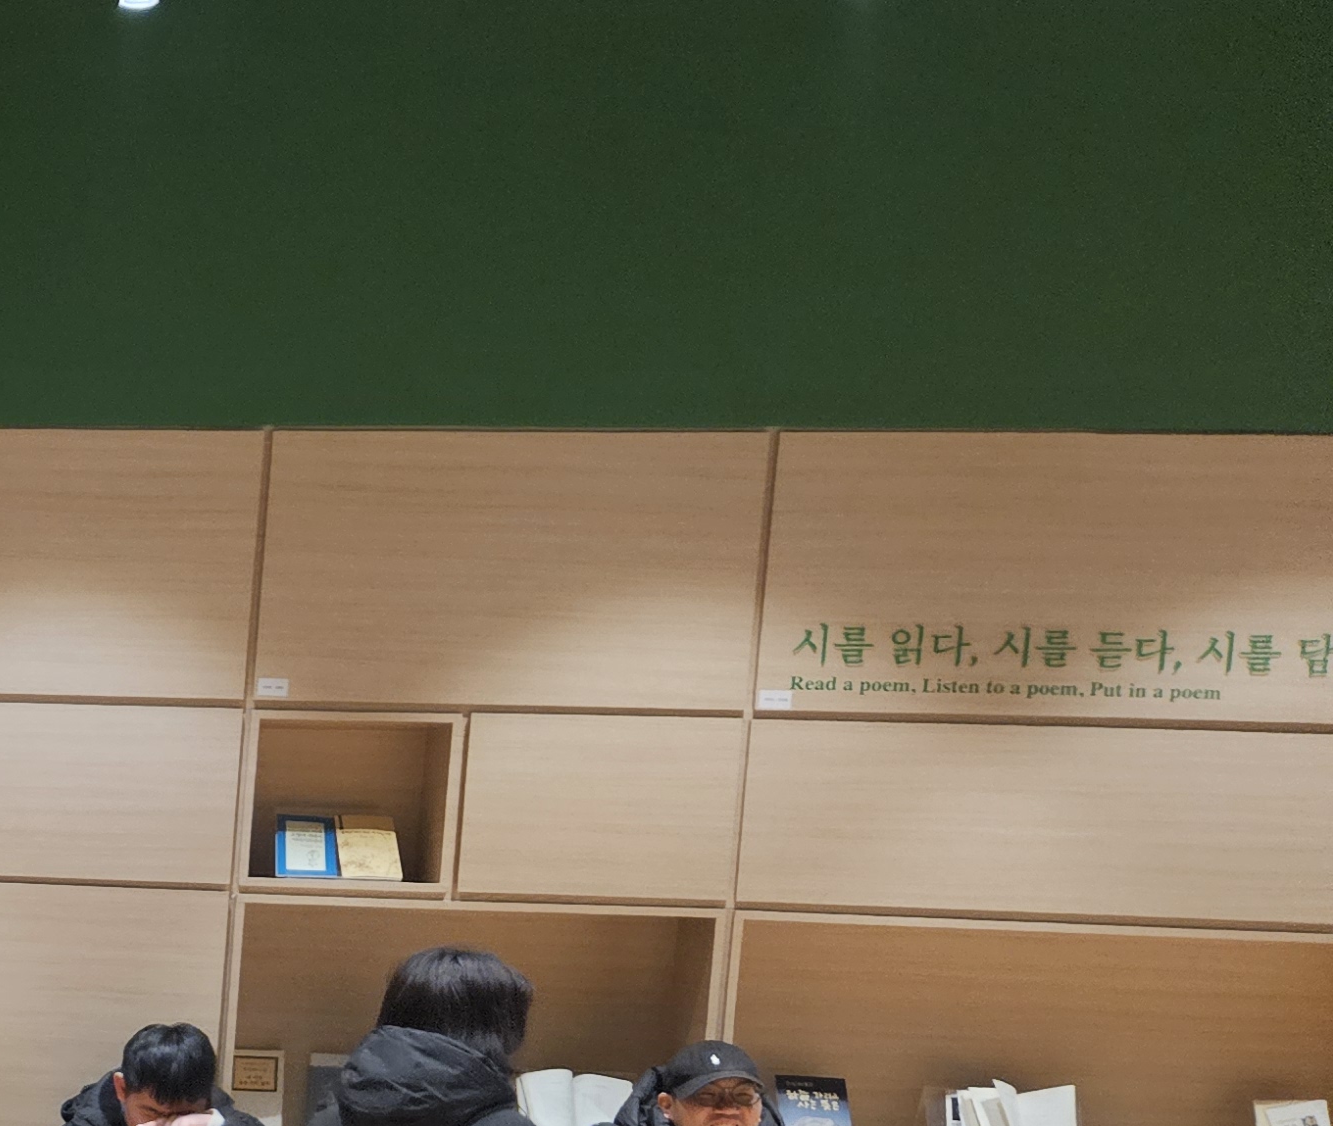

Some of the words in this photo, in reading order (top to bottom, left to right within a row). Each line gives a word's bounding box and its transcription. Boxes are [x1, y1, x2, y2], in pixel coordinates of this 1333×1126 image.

[793, 622, 874, 668] 시를
[891, 623, 979, 668] 읽다,
[993, 625, 1077, 669] 시를
[1089, 629, 1183, 676] 듣다,
[1196, 630, 1282, 676] 시를
[789, 675, 837, 692] Read
[843, 681, 853, 691] a
[859, 680, 917, 696] poem,
[922, 678, 980, 694] Listen
[986, 681, 1005, 695] to
[1010, 684, 1021, 695] a
[1026, 683, 1085, 699] poem,
[1090, 681, 1123, 698] Put
[1128, 683, 1147, 698] in
[1152, 687, 1164, 698] a
[1169, 686, 1222, 702] poem
